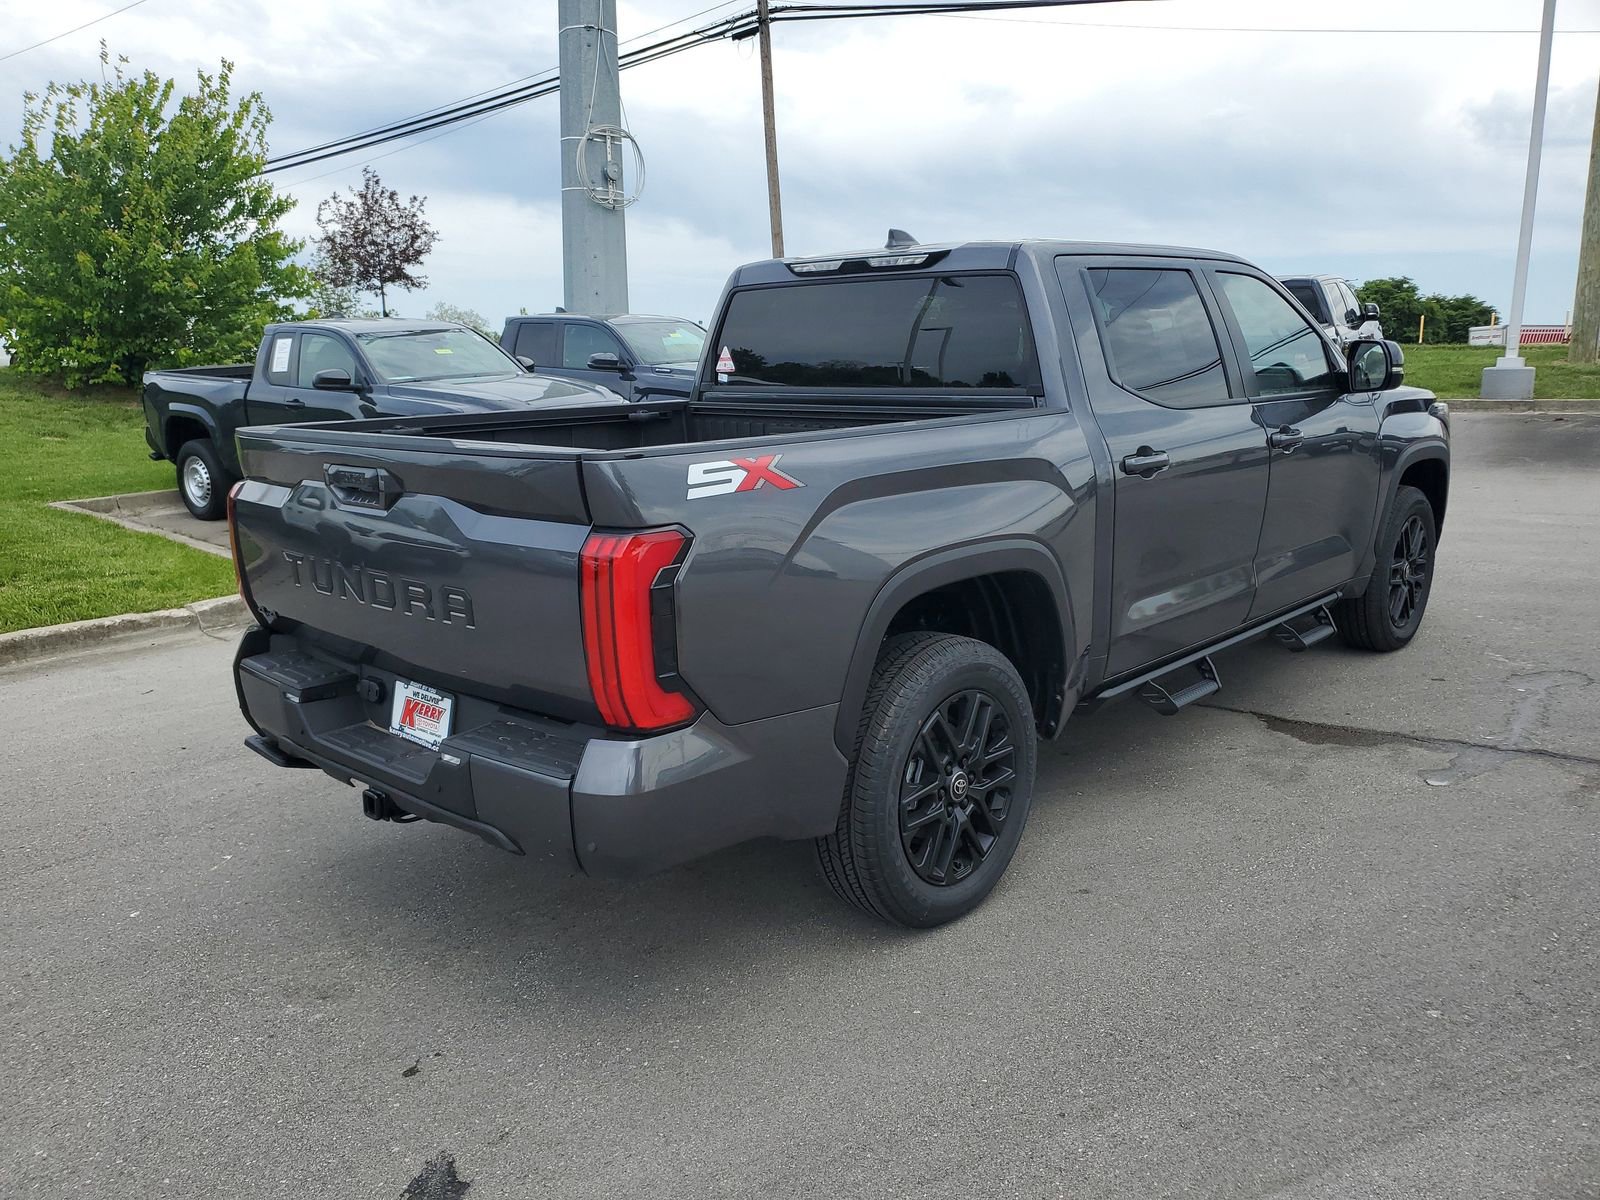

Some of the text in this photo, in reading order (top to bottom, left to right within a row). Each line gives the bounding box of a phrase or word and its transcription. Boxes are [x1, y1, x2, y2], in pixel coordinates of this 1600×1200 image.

[282, 551, 476, 629] TUNDRA
[413, 690, 439, 705] WE DELIVER
[400, 699, 443, 728] KERRY
